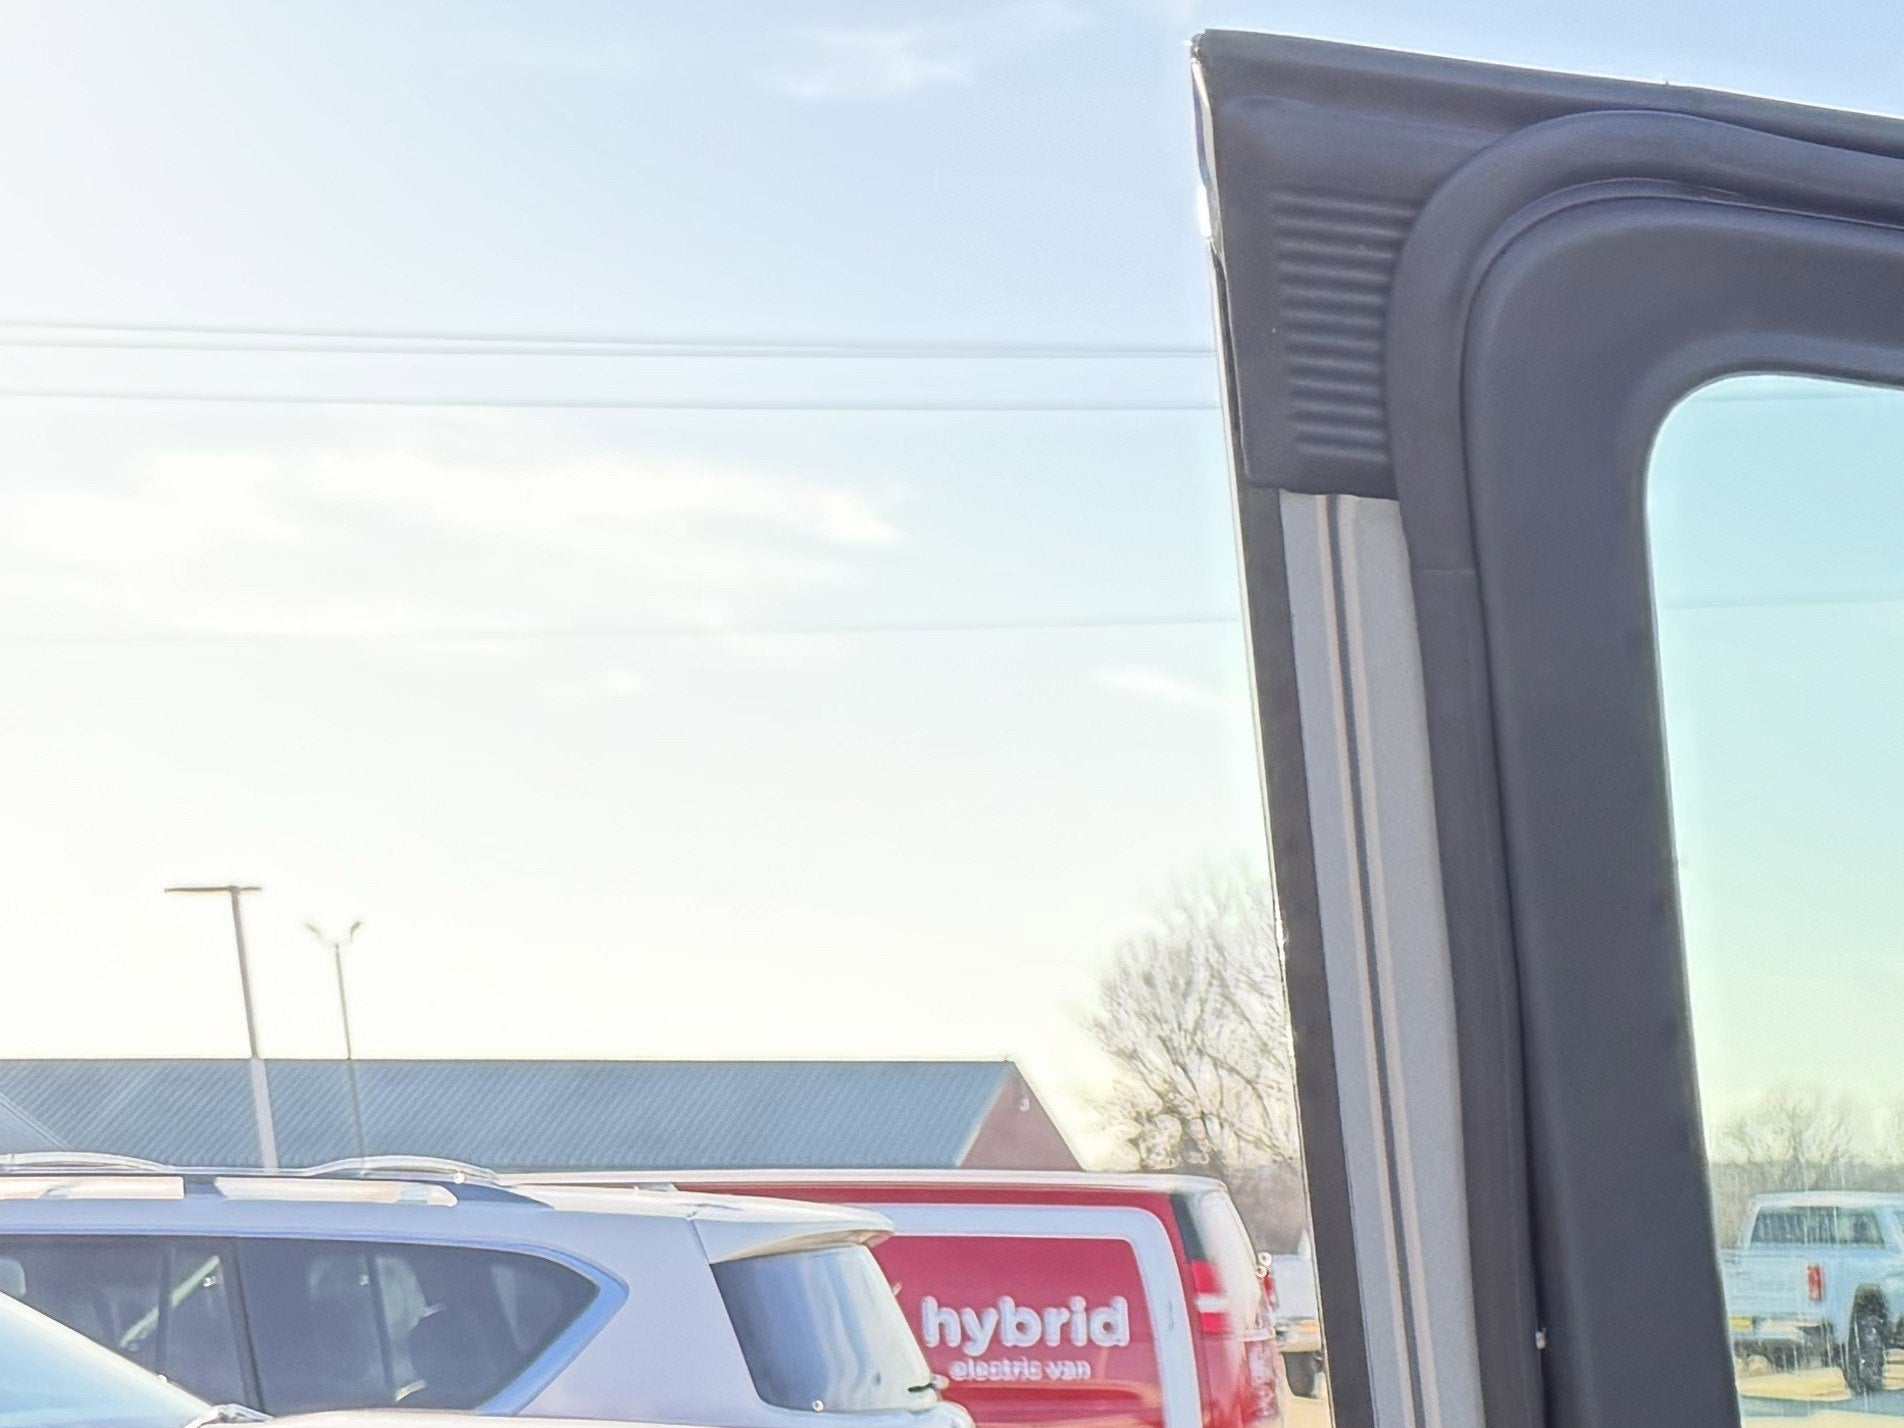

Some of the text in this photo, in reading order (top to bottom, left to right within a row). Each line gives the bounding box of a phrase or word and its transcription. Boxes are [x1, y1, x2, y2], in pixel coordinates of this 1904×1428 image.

[921, 1296, 1131, 1357] hybrid
[950, 1356, 1092, 1381] electric van
